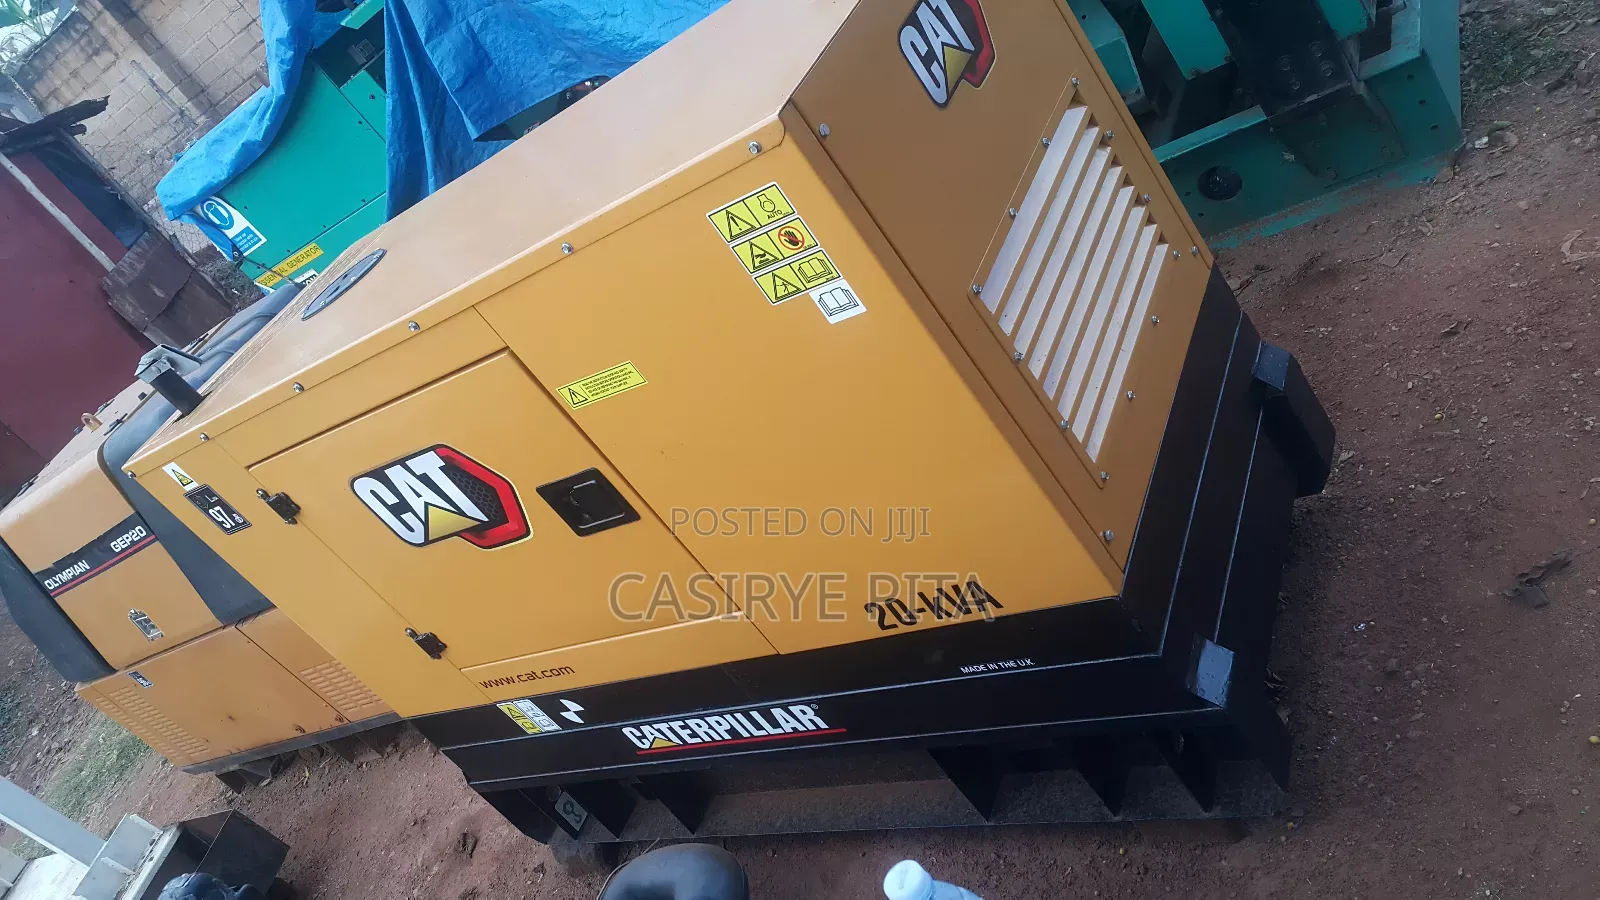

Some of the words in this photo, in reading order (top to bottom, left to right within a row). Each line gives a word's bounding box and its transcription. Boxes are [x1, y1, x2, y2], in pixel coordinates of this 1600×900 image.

[900, 0, 975, 104] CAT
[767, 209, 783, 219] AUTO
[286, 245, 320, 269] GENERATOR
[353, 450, 490, 544] CAT
[208, 505, 235, 528] 97
[43, 559, 91, 590] OLYMPIAN
[110, 525, 147, 552] GEP20
[478, 665, 576, 689] www.cat.com
[960, 664, 987, 673] MADE
[987, 662, 999, 670] IN
[998, 660, 1017, 668] THE
